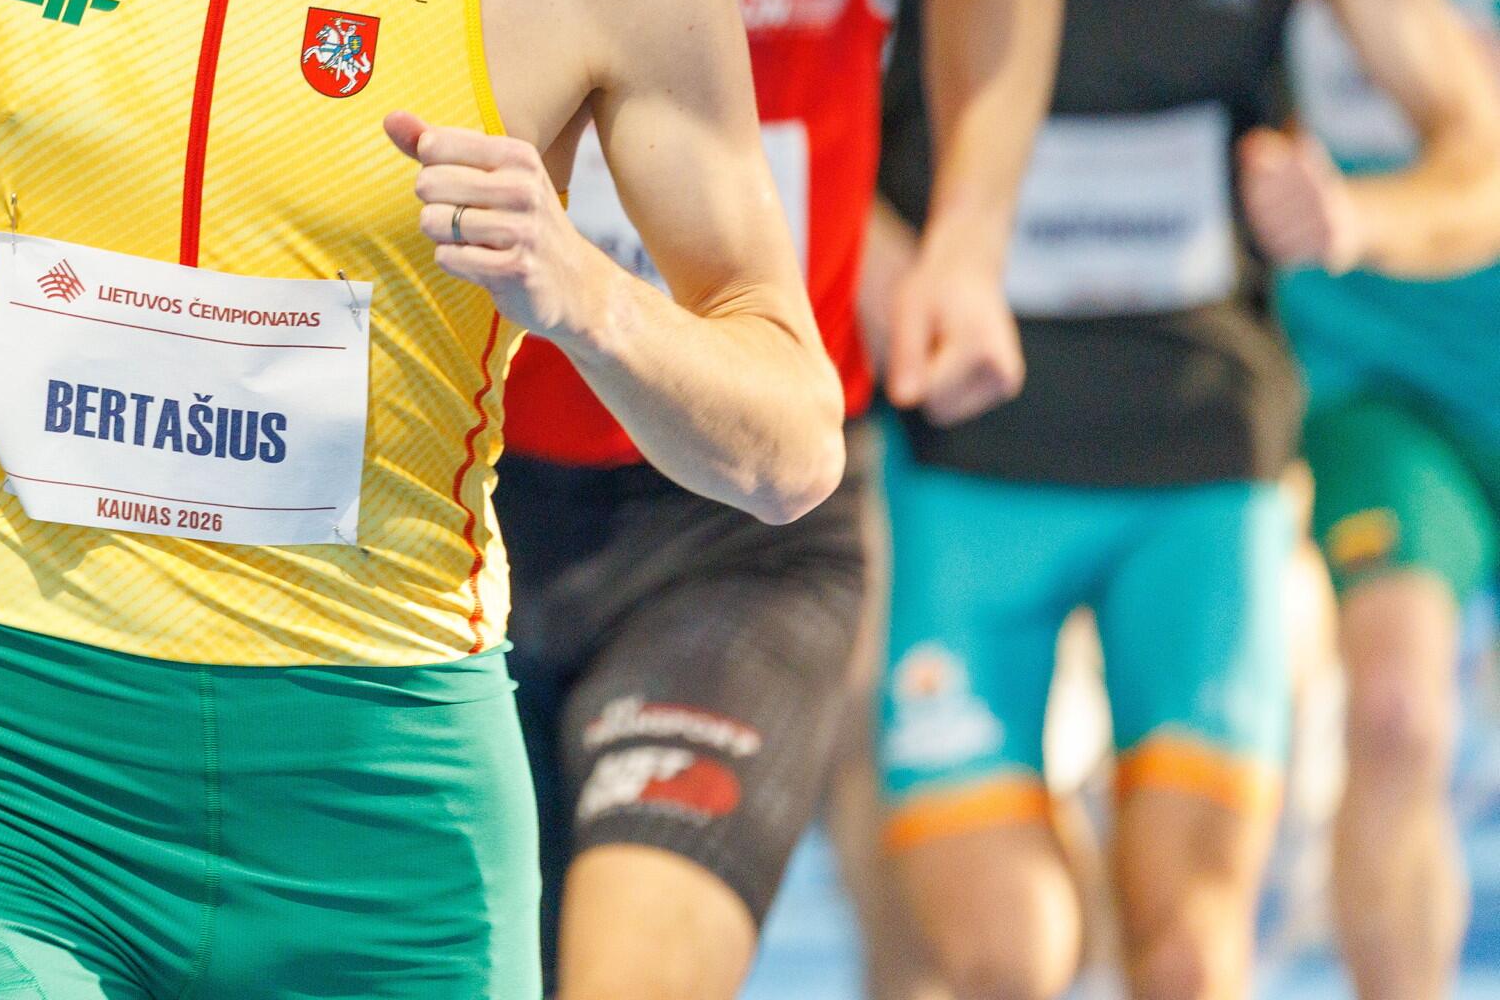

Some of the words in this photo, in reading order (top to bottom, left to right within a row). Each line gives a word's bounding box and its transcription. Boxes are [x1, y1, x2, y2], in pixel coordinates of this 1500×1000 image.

[97, 285, 182, 315] LIETUVOS
[188, 298, 321, 328] ČEMPIONATAS
[44, 379, 287, 464] BERTAŠIUS
[97, 497, 171, 526] KAUNAS
[177, 511, 223, 532] 2026
